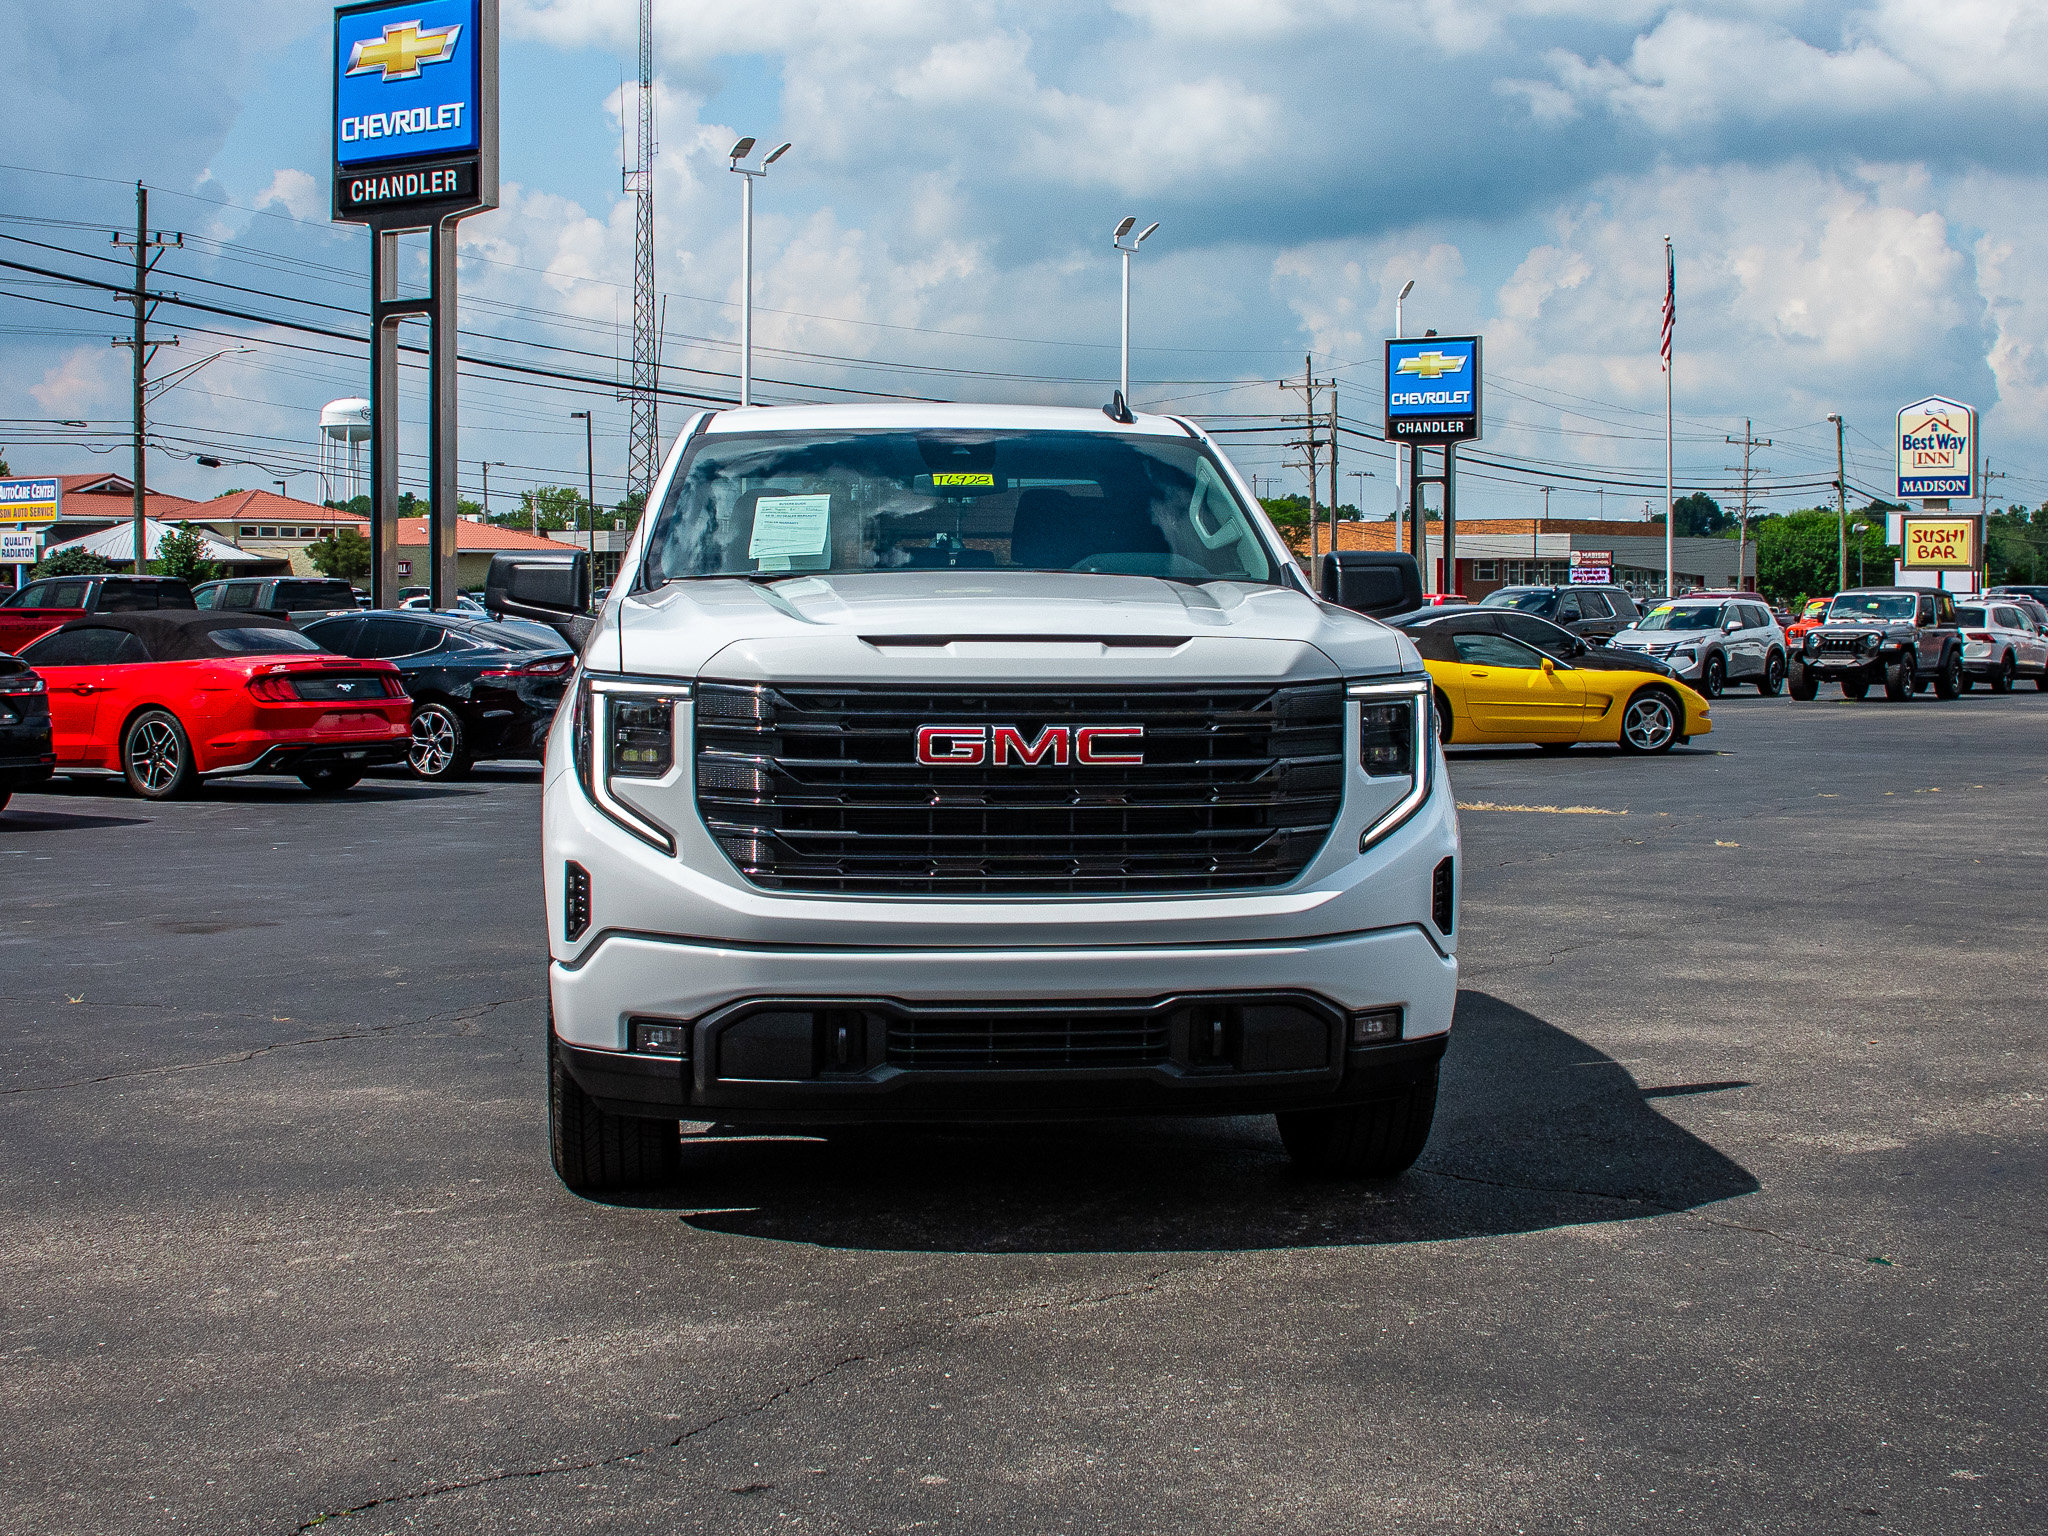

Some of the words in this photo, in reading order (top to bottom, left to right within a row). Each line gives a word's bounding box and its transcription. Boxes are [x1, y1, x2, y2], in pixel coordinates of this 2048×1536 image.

[341, 102, 465, 142] CHEVROLET
[351, 169, 457, 202] CHANDLER
[1391, 391, 1470, 406] CHEVROLET
[1397, 421, 1464, 433] CHANDLER
[1902, 434, 1935, 451] Best
[1936, 434, 1967, 454] Way
[1916, 452, 1950, 465] INN
[31, 483, 56, 499] CENTER
[1901, 480, 1967, 493] MADISON
[13, 507, 28, 518] AUTO
[30, 505, 54, 517] SERVICE
[4, 536, 32, 547] QUALITY
[1912, 528, 1965, 544] SUSHI
[1, 548, 35, 558] RADIATOR
[1917, 545, 1957, 559] BAR
[916, 725, 1145, 766] GMC
